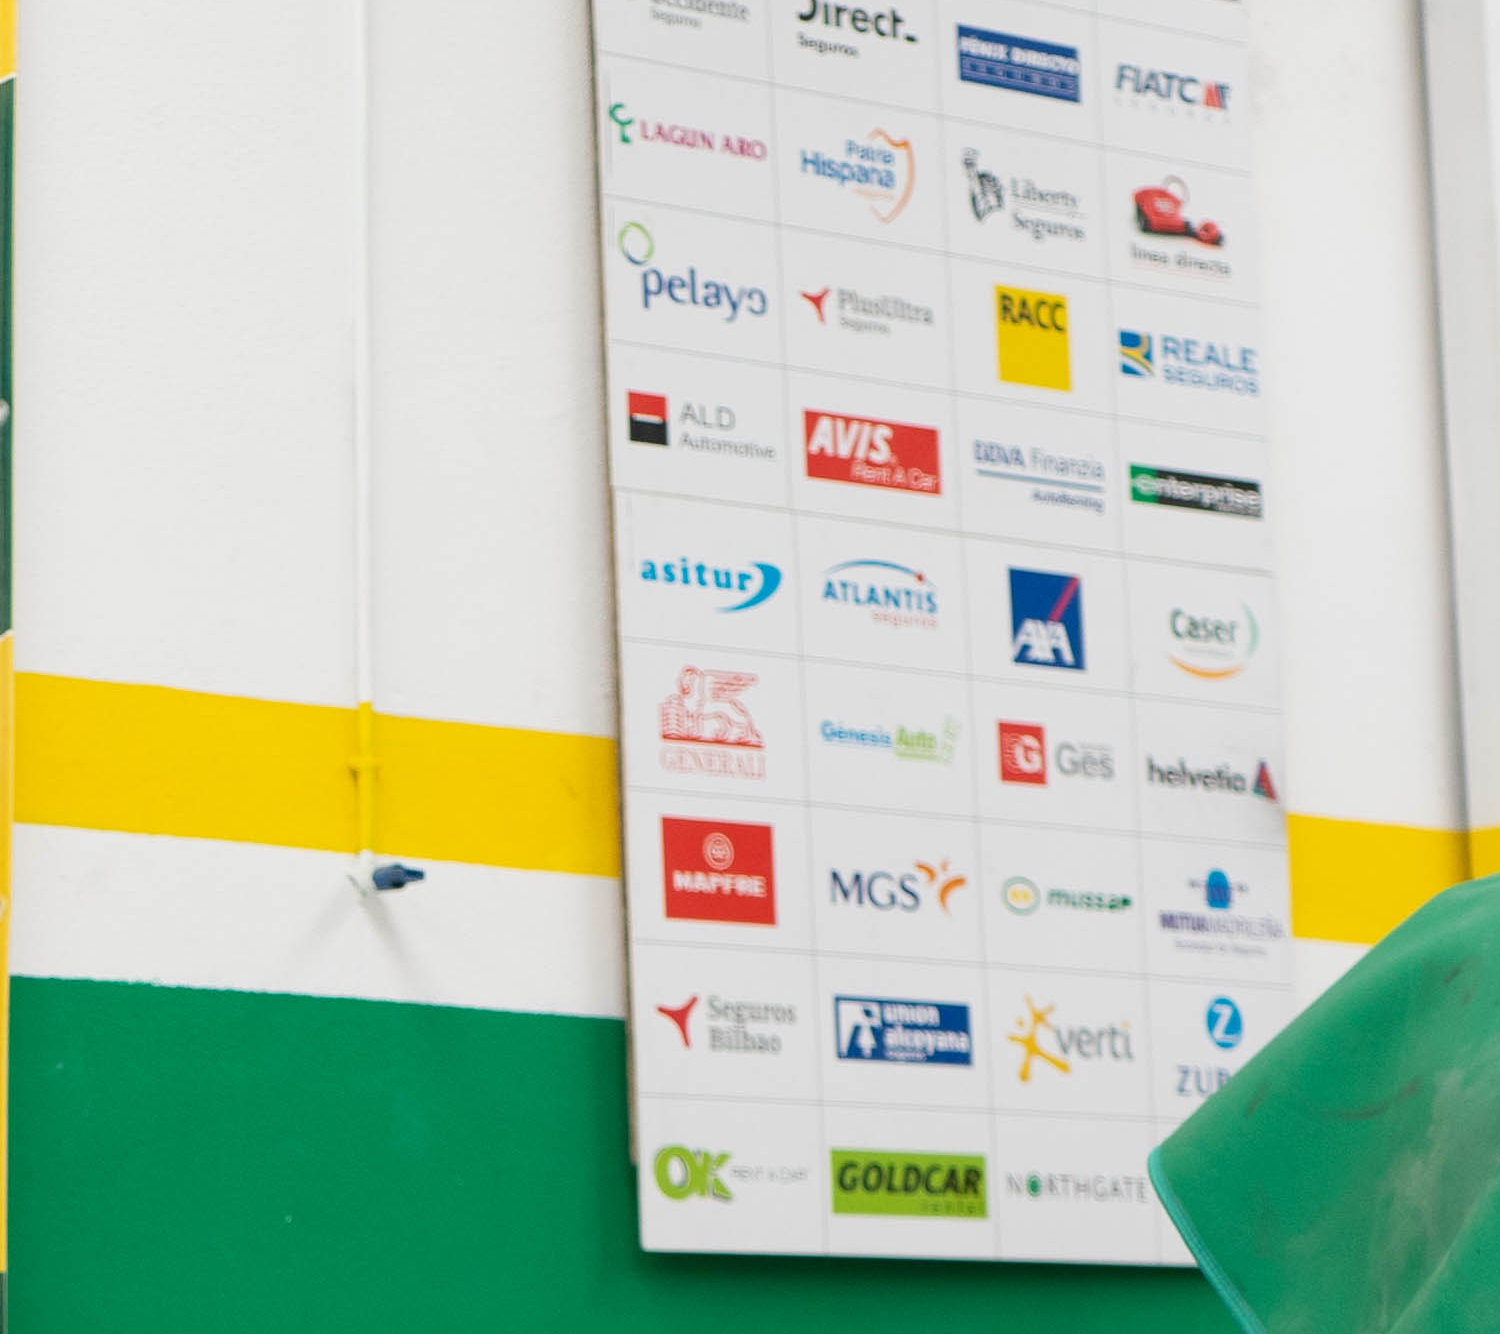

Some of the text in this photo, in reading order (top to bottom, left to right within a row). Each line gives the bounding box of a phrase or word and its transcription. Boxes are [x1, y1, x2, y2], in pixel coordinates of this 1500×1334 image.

[1117, 63, 1198, 105] FIATC
[639, 120, 768, 161] LAGUN ARO
[800, 150, 896, 190] Hispana
[1012, 211, 1087, 244] Seguros
[642, 266, 768, 323] pelayo
[1000, 293, 1066, 332] RACC
[1162, 334, 1259, 374] REALE
[1163, 365, 1260, 397] SEGUROS
[679, 402, 737, 432] ALD
[679, 432, 777, 462] Automotive
[973, 439, 1025, 468] BBVA
[852, 465, 890, 484] Rent
[908, 469, 938, 492] Car
[1130, 472, 1261, 509] enterprise
[641, 557, 752, 593] asitur
[822, 579, 938, 614] ATLANTIS
[1012, 618, 1077, 666] AXA
[1170, 607, 1237, 645] Caser
[659, 746, 767, 781] GENERALI
[1055, 741, 1114, 780] Ges
[1147, 755, 1247, 793] helvetia
[672, 870, 767, 898] MAPFRE
[830, 868, 921, 911] MGS
[706, 995, 797, 1028] Seguros
[709, 1026, 783, 1055] Bilbao
[883, 1023, 969, 1056] alcoyana
[1055, 1020, 1135, 1061] verti
[654, 1144, 733, 1203] OK
[836, 1162, 983, 1196] GOLDCAR
[1006, 1172, 1148, 1204] NORTHGATE
